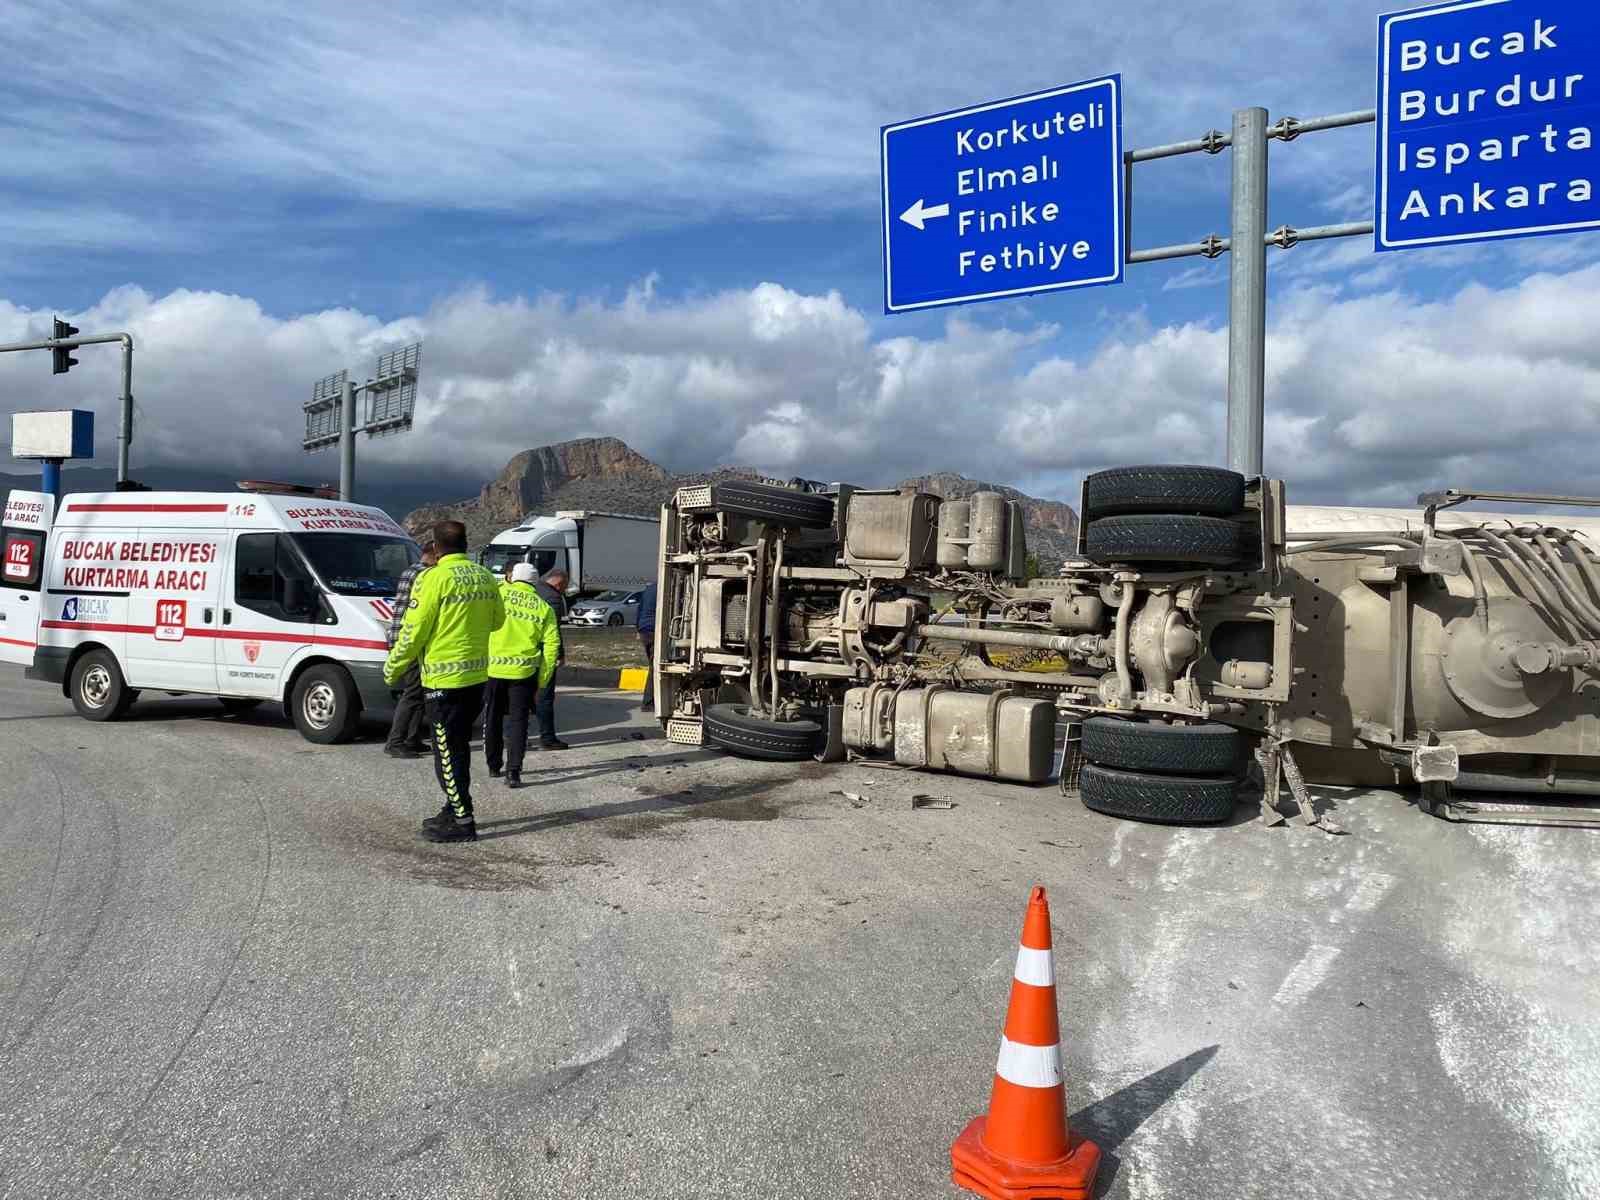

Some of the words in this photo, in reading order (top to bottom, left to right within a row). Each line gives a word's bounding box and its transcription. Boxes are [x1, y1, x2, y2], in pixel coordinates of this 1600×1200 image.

[1401, 19, 1557, 71] Bucak
[1399, 74, 1583, 121] Burdur
[956, 103, 1105, 155] Korkuteli
[1399, 124, 1592, 174] Isparta
[957, 156, 1058, 196] Elmalı
[1399, 178, 1592, 220] Ankara
[958, 202, 1059, 236] Finike
[959, 240, 1090, 276] Fethiye
[235, 504, 256, 516] 112
[286, 508, 334, 519] BUCAK
[301, 519, 373, 530] KURTARMA
[11, 544, 30, 562] 112
[63, 541, 116, 560] BUCAK
[63, 567, 149, 589] KURTARMA
[154, 570, 207, 591] ARACI
[79, 598, 110, 613] BUCAK
[160, 604, 182, 624] 112
